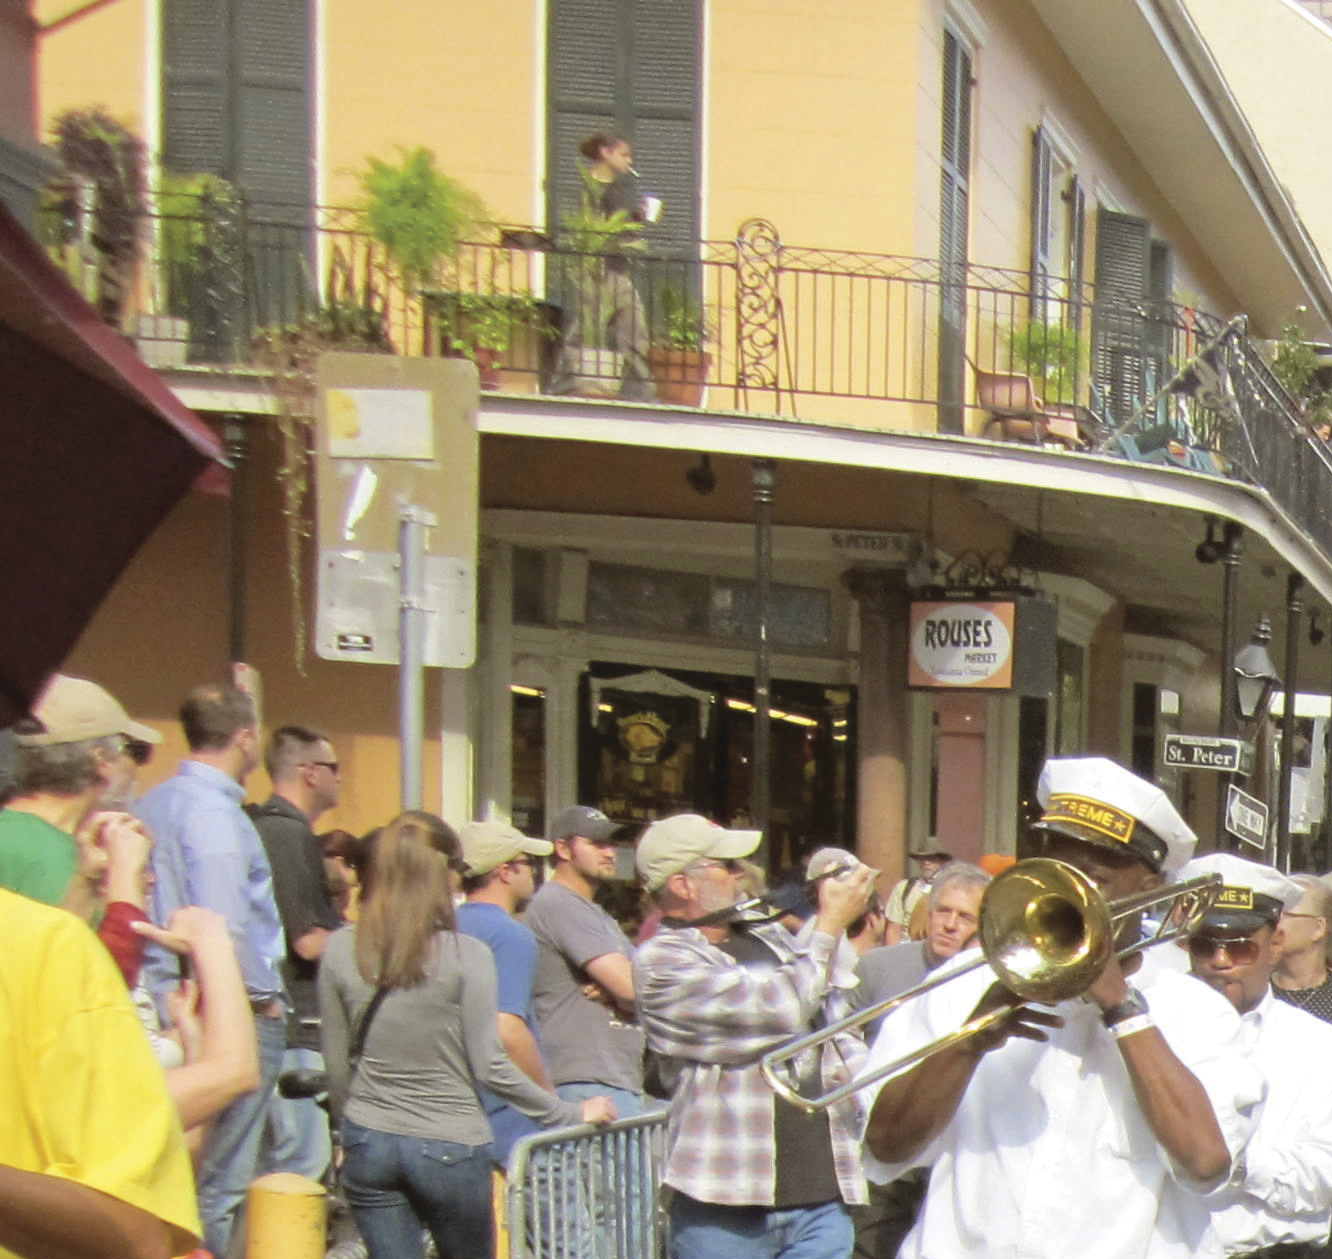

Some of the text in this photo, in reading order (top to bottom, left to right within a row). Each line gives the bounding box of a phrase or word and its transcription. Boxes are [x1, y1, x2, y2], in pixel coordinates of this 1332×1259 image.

[846, 535, 888, 550] PETER
[924, 619, 993, 649] ROUSES
[964, 652, 998, 665] MARKET
[1168, 745, 1234, 766] St. Peter
[1060, 801, 1116, 827] TREME
